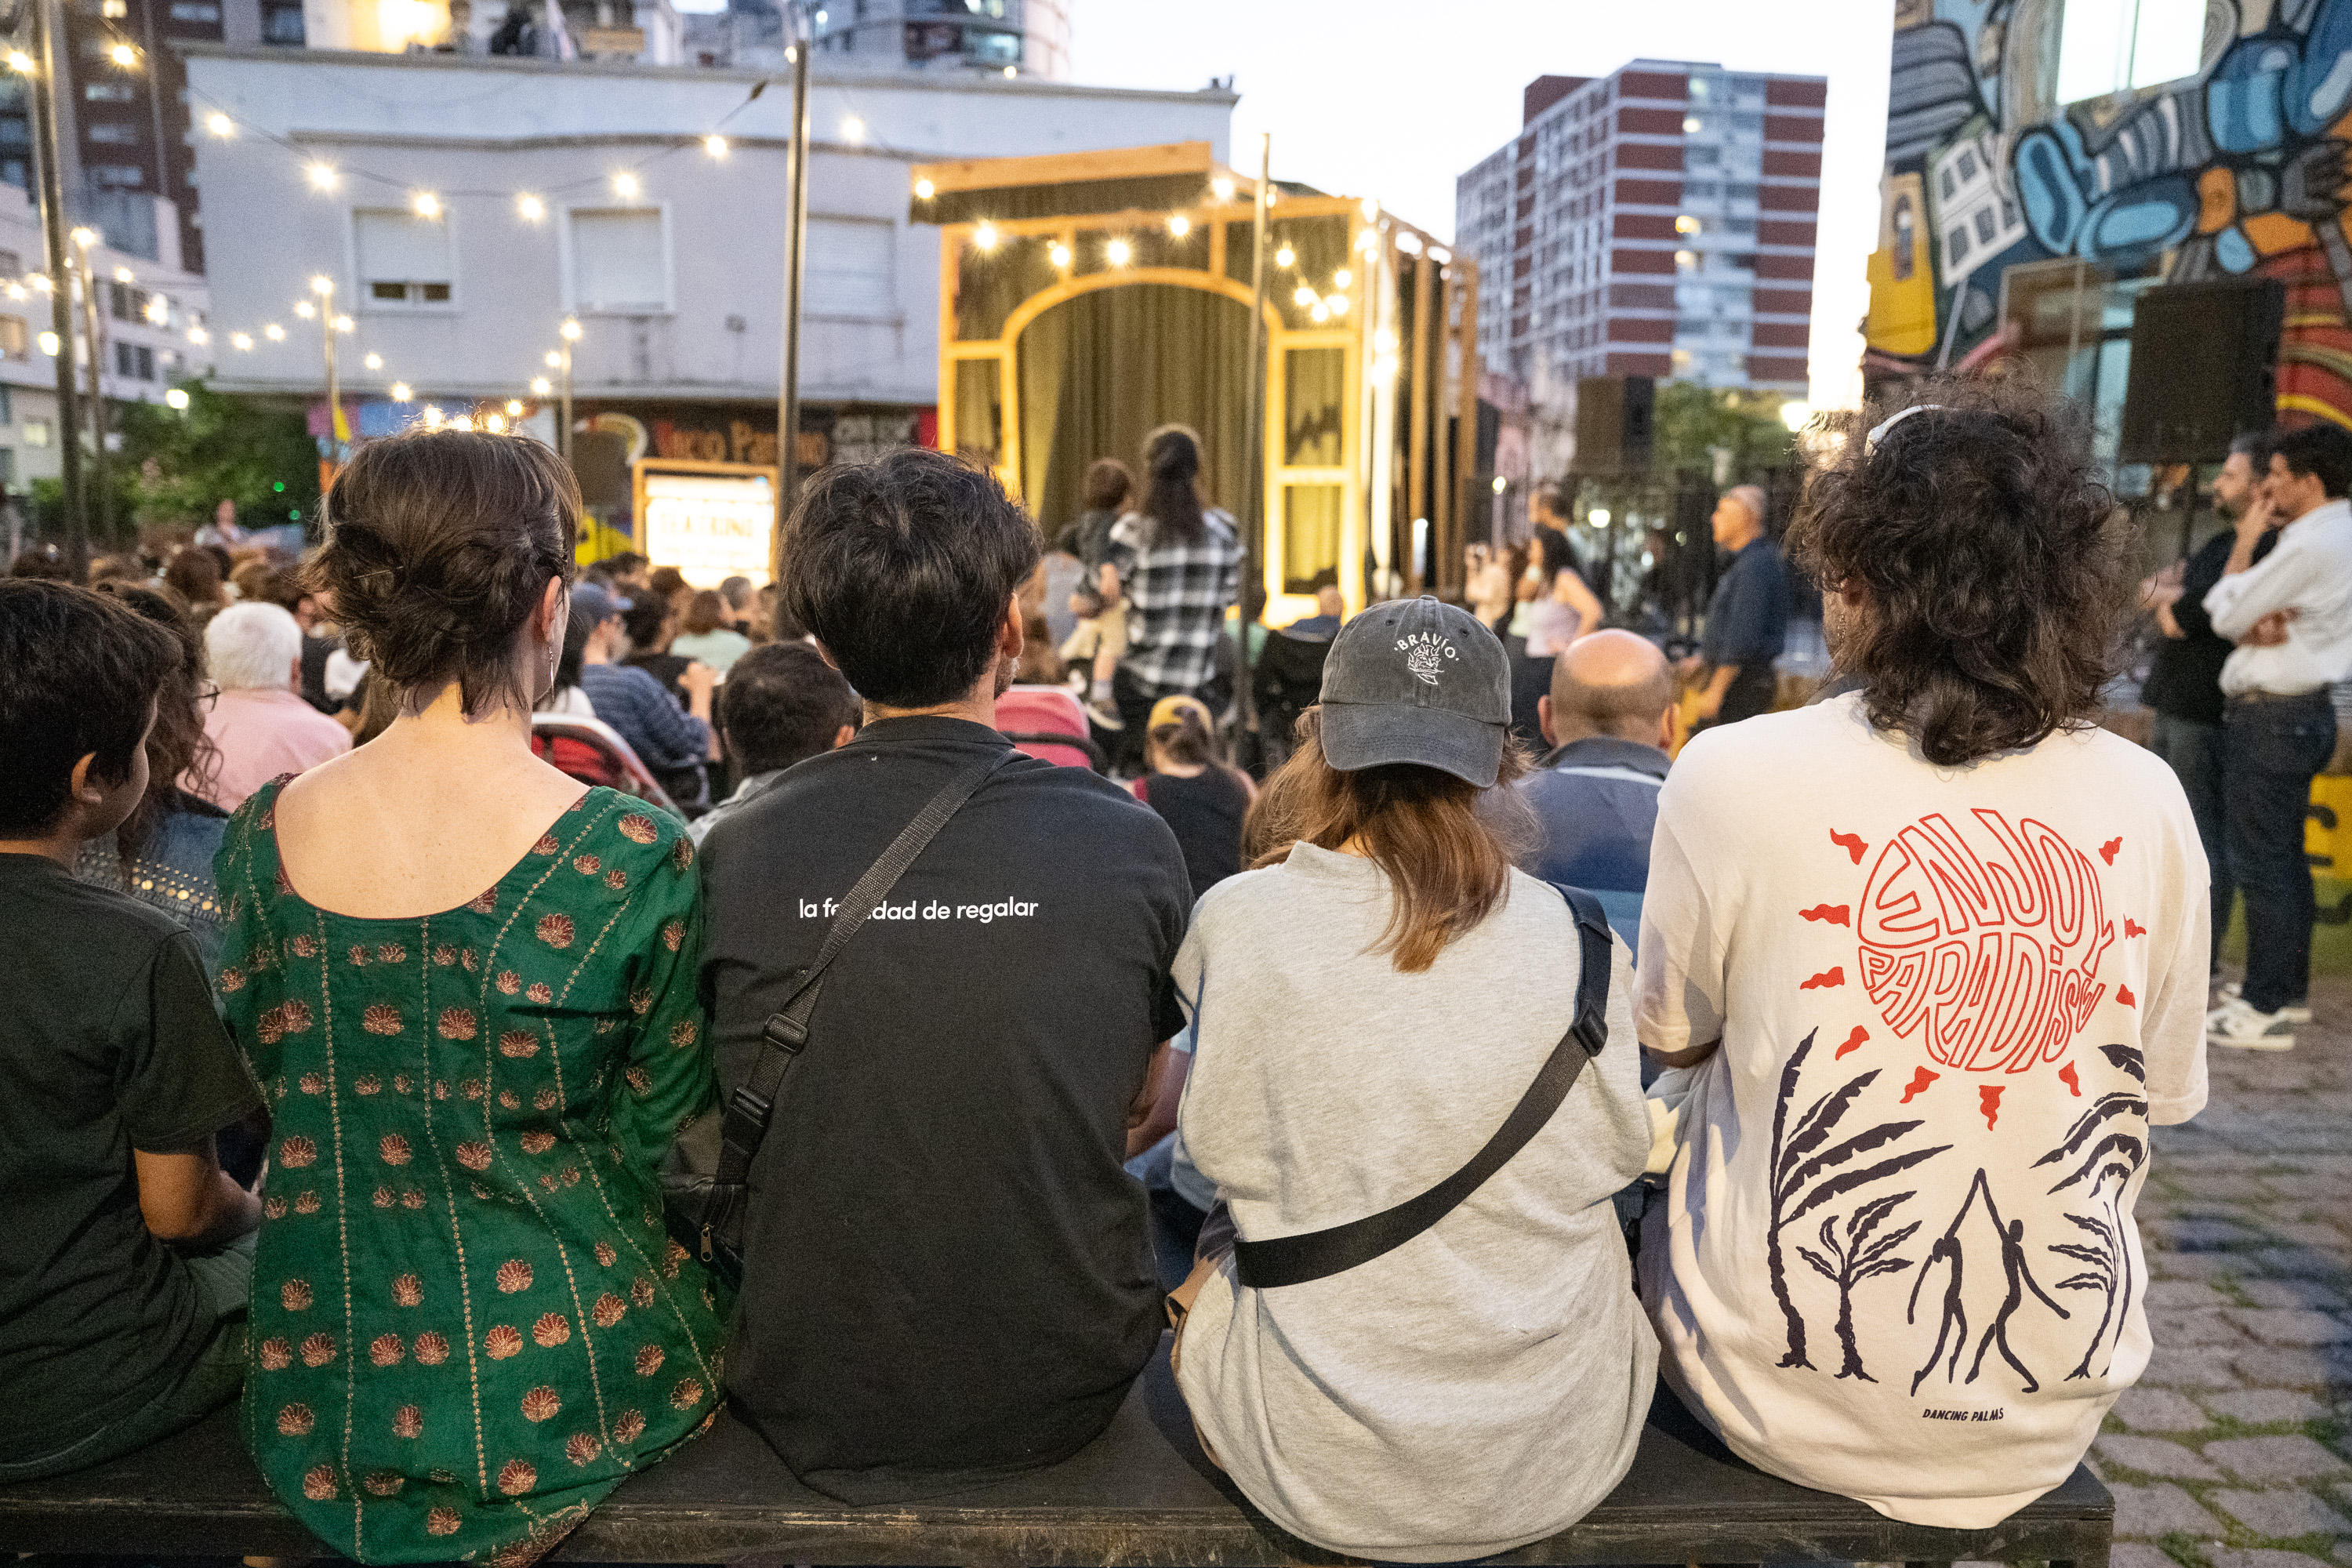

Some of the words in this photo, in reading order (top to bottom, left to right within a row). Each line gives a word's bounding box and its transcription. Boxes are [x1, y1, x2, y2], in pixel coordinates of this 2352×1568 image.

[1857, 808, 2114, 979] ENJOY
[799, 898, 818, 919] la
[922, 900, 951, 920] de
[956, 895, 1039, 924] regalar
[1922, 1408, 1969, 1421] DANCING
[1971, 1407, 2004, 1422] PALMS
